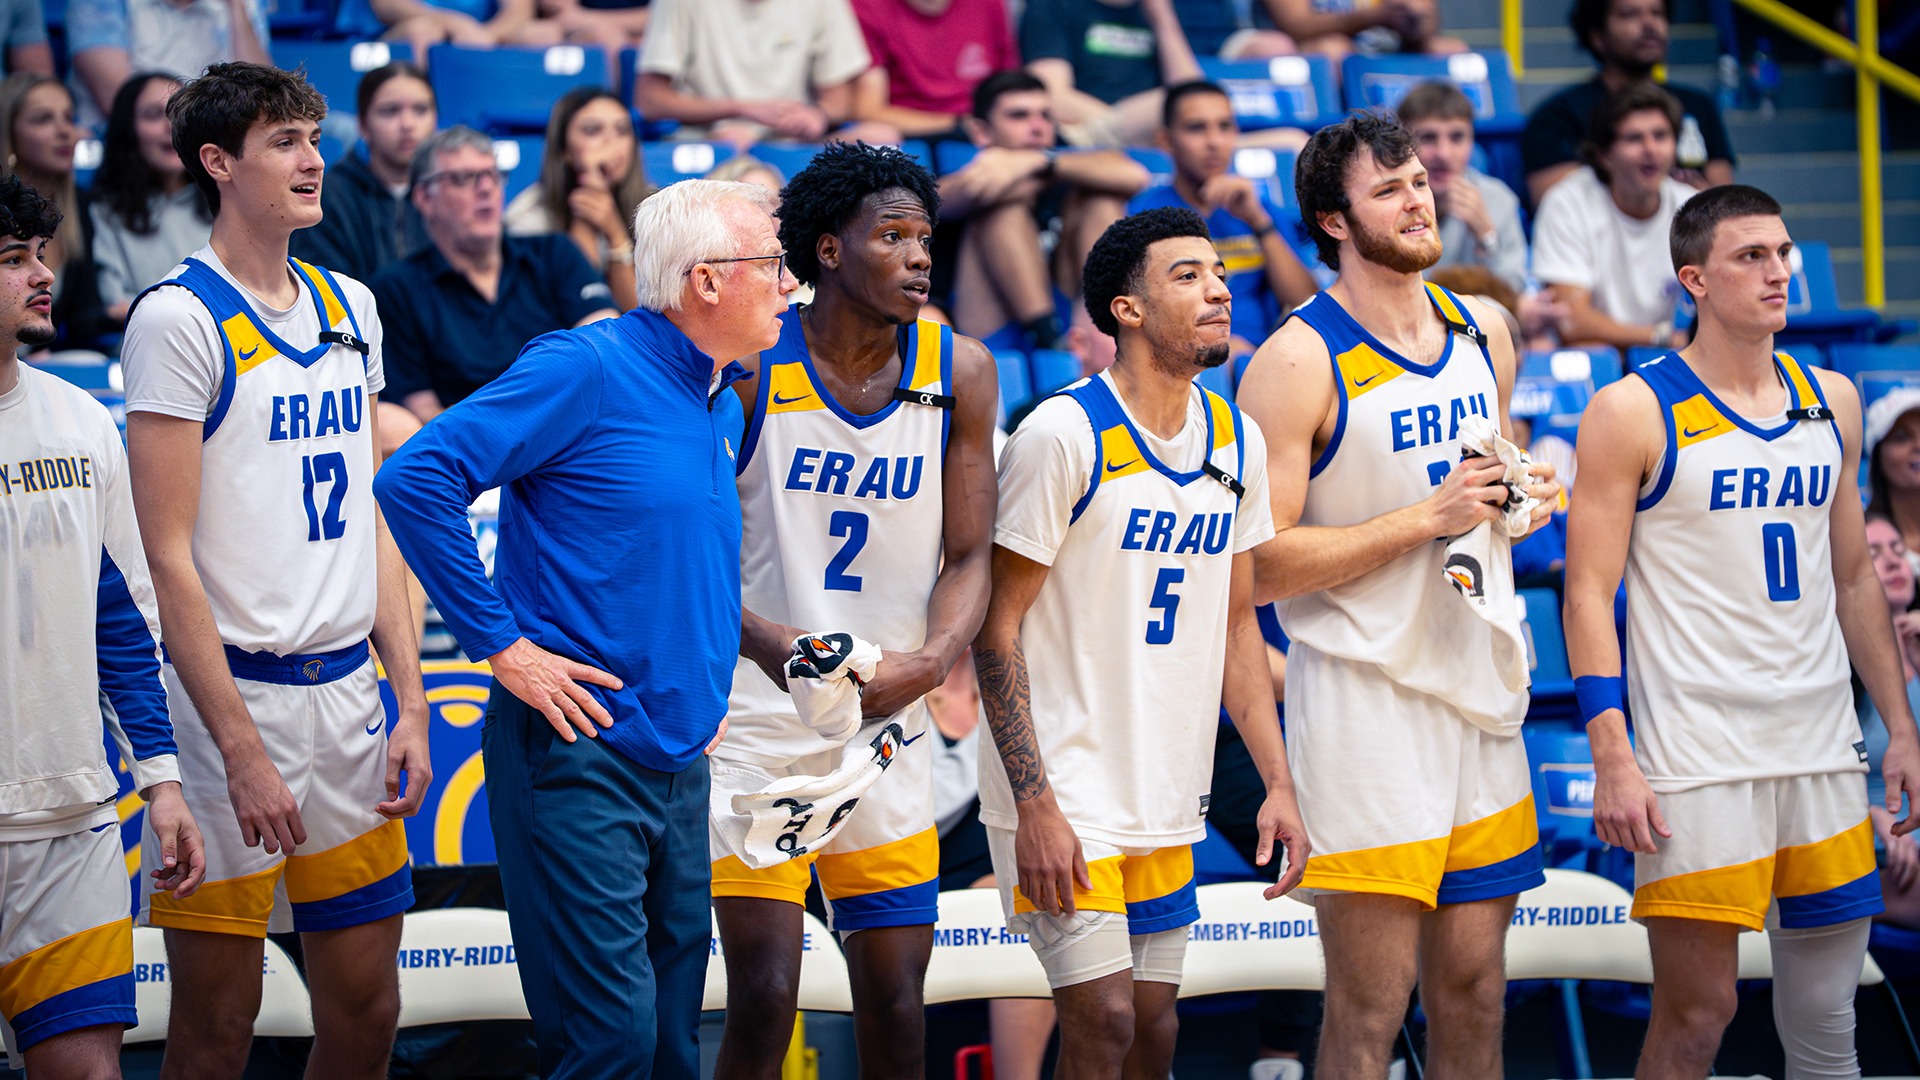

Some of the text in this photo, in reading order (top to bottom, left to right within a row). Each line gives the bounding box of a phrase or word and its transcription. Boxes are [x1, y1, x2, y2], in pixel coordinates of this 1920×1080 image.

[341, 333, 354, 346] CK
[269, 386, 362, 441] ERAU
[919, 393, 934, 405] CK
[0, 456, 91, 496] Y-RIDDLE
[302, 452, 348, 541] 12
[786, 448, 924, 499] ERAU
[1220, 473, 1234, 488] CK
[1710, 465, 1831, 510] ERAU
[823, 510, 869, 593] 2
[1122, 508, 1233, 555] ERAU
[1761, 521, 1801, 603] 0
[1146, 568, 1185, 645] 5
[1187, 919, 1320, 941] MBRY-RIDDL
